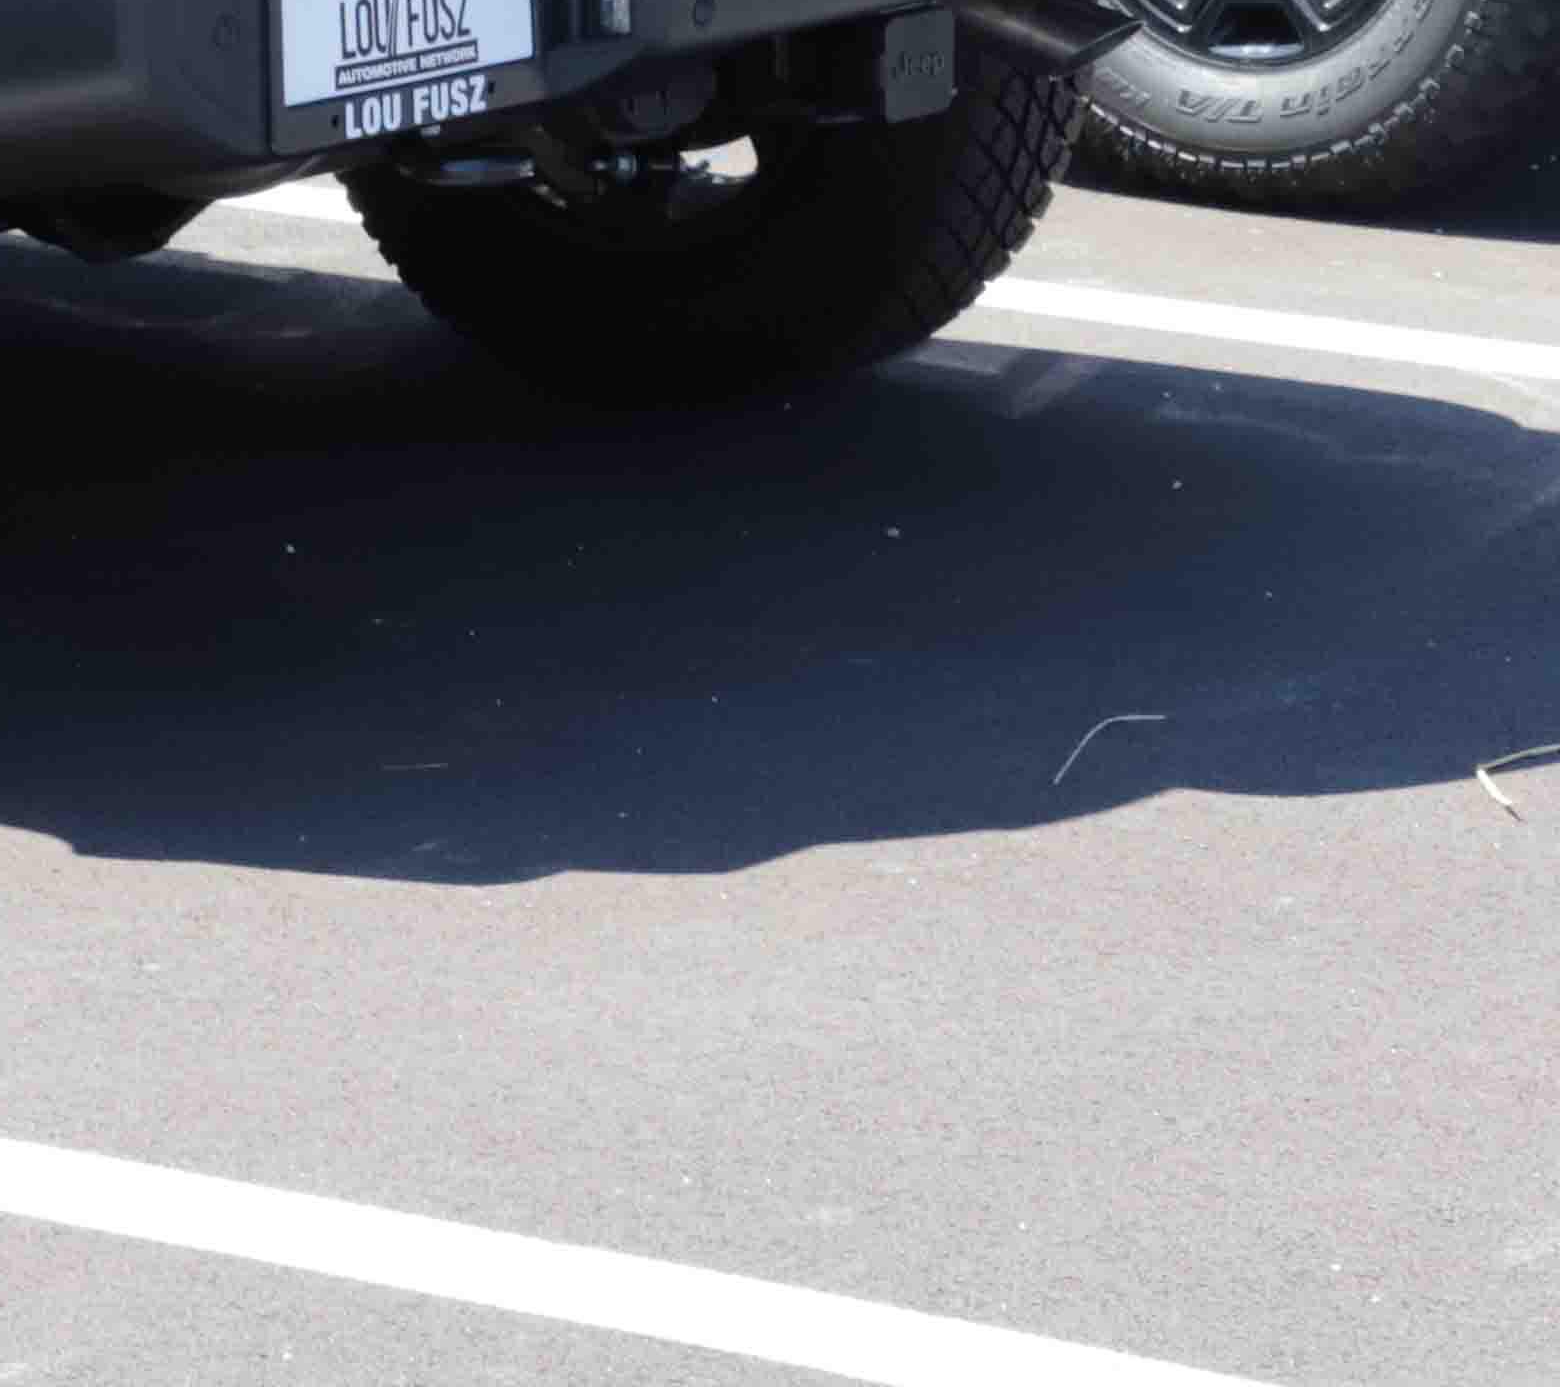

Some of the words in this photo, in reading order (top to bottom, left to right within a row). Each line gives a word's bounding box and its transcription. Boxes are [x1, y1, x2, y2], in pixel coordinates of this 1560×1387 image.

[337, 56, 418, 86] AUTOMOTIVE
[419, 43, 477, 72] NETWORK
[344, 91, 402, 140] LOU
[412, 73, 488, 125] FUSZ
